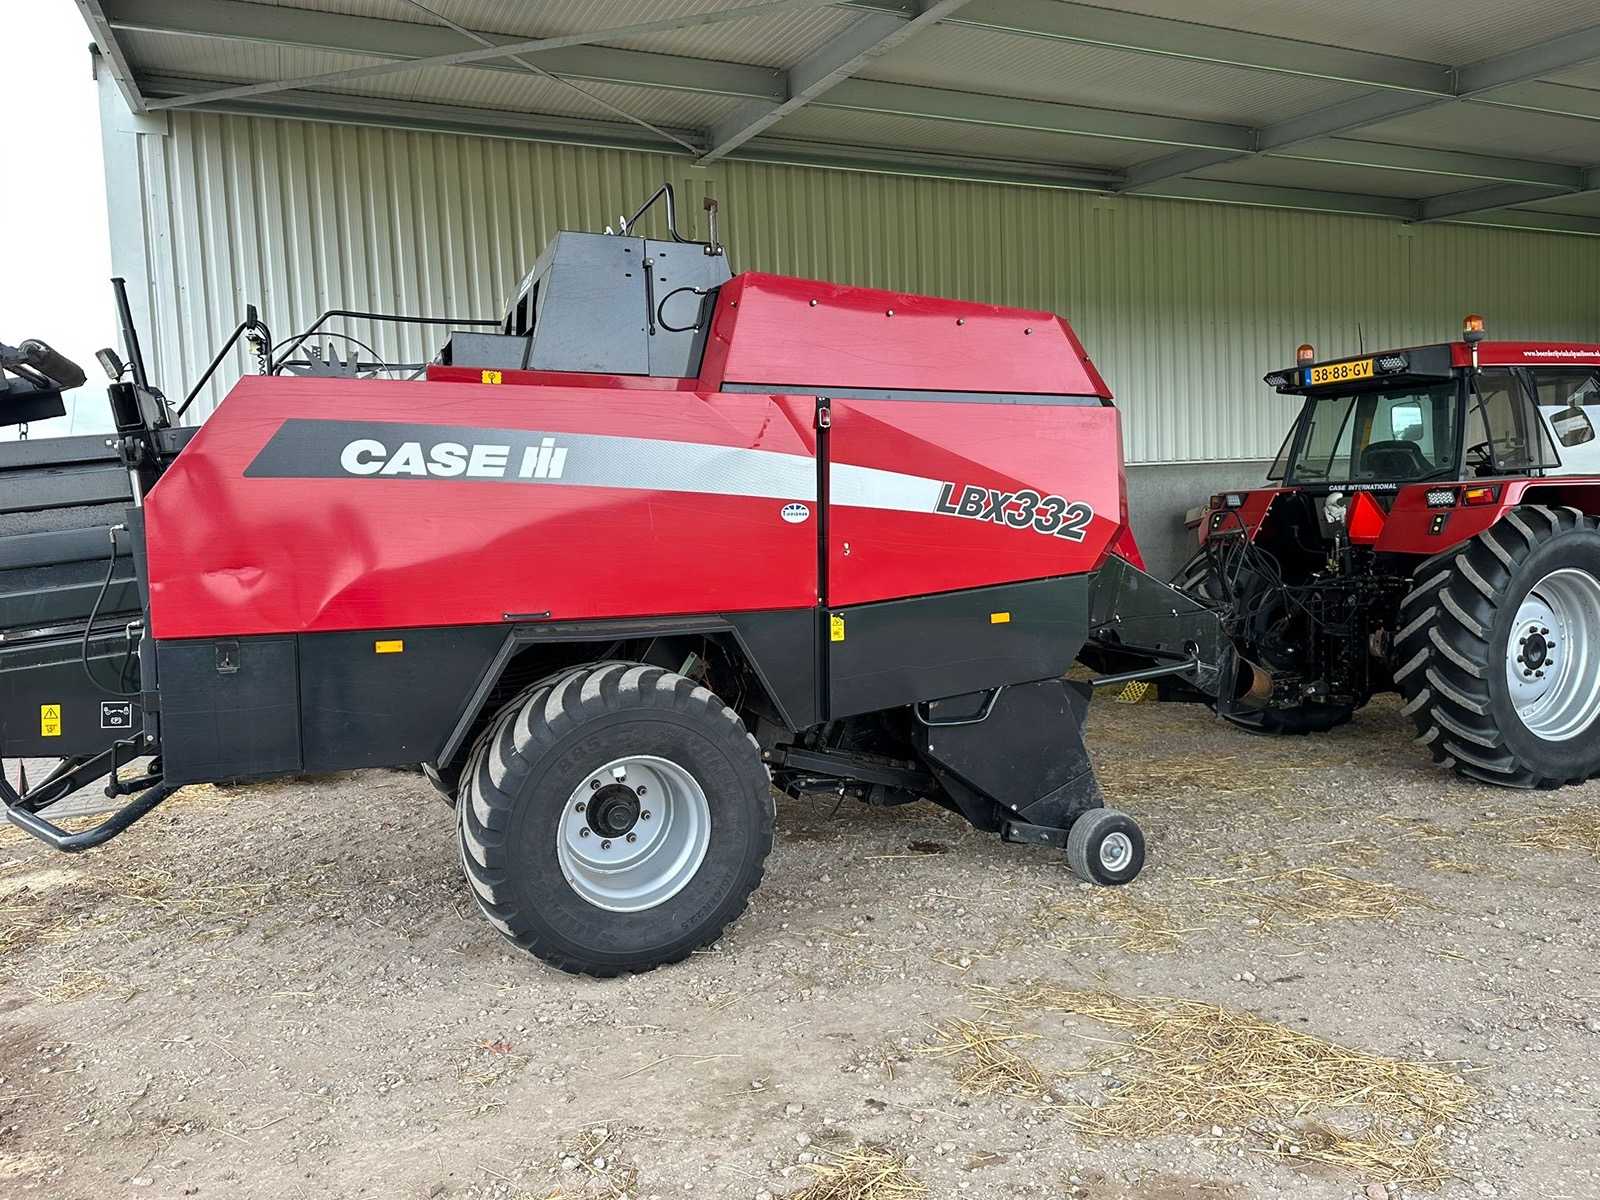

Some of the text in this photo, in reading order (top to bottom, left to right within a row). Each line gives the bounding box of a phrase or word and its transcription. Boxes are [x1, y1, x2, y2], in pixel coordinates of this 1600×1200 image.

[1314, 362, 1369, 382] 38-88-GV
[340, 439, 511, 477] CASE
[934, 482, 1094, 543] LBX332
